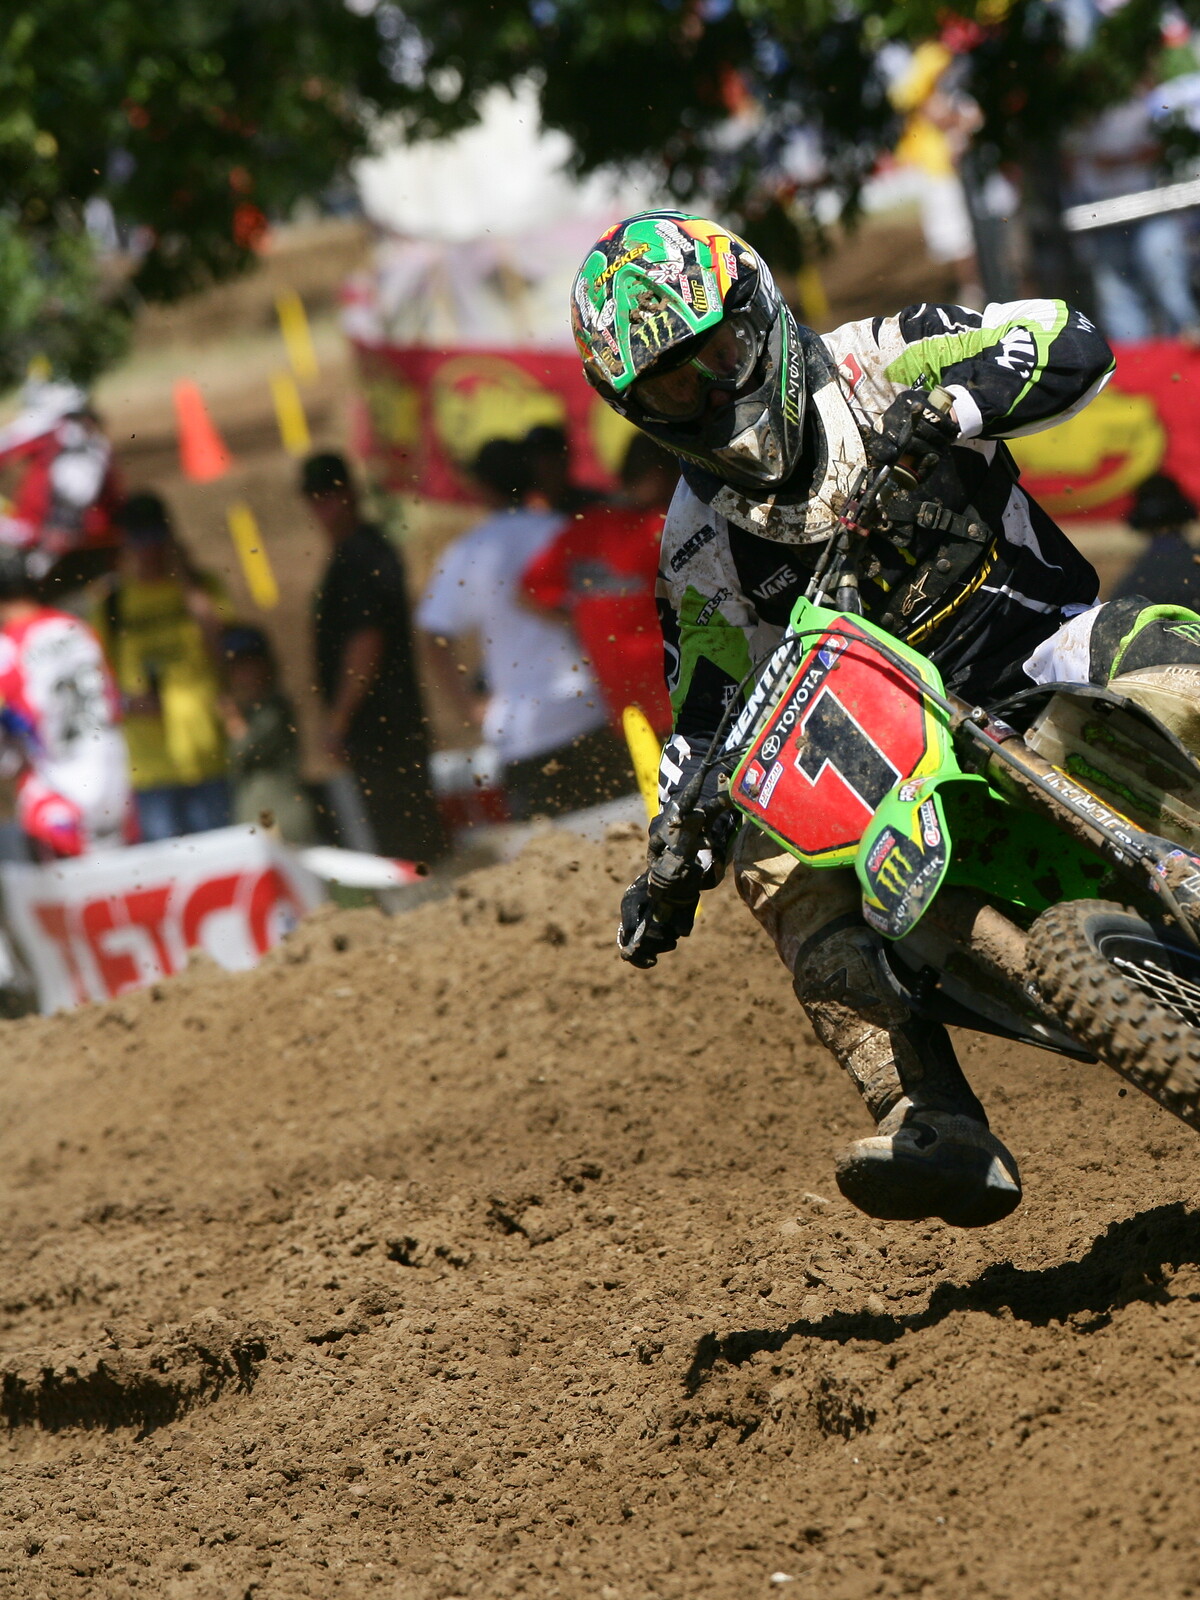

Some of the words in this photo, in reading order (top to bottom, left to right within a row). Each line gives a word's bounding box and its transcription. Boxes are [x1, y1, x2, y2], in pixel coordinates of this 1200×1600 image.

[598, 243, 651, 284] KICKER
[724, 253, 738, 280] VANS
[679, 274, 692, 304] TREK
[691, 280, 709, 313] thor
[671, 524, 714, 566] PARTS
[752, 564, 798, 600] VANS
[776, 669, 823, 734] TOYOTA
[793, 684, 903, 818] 1
